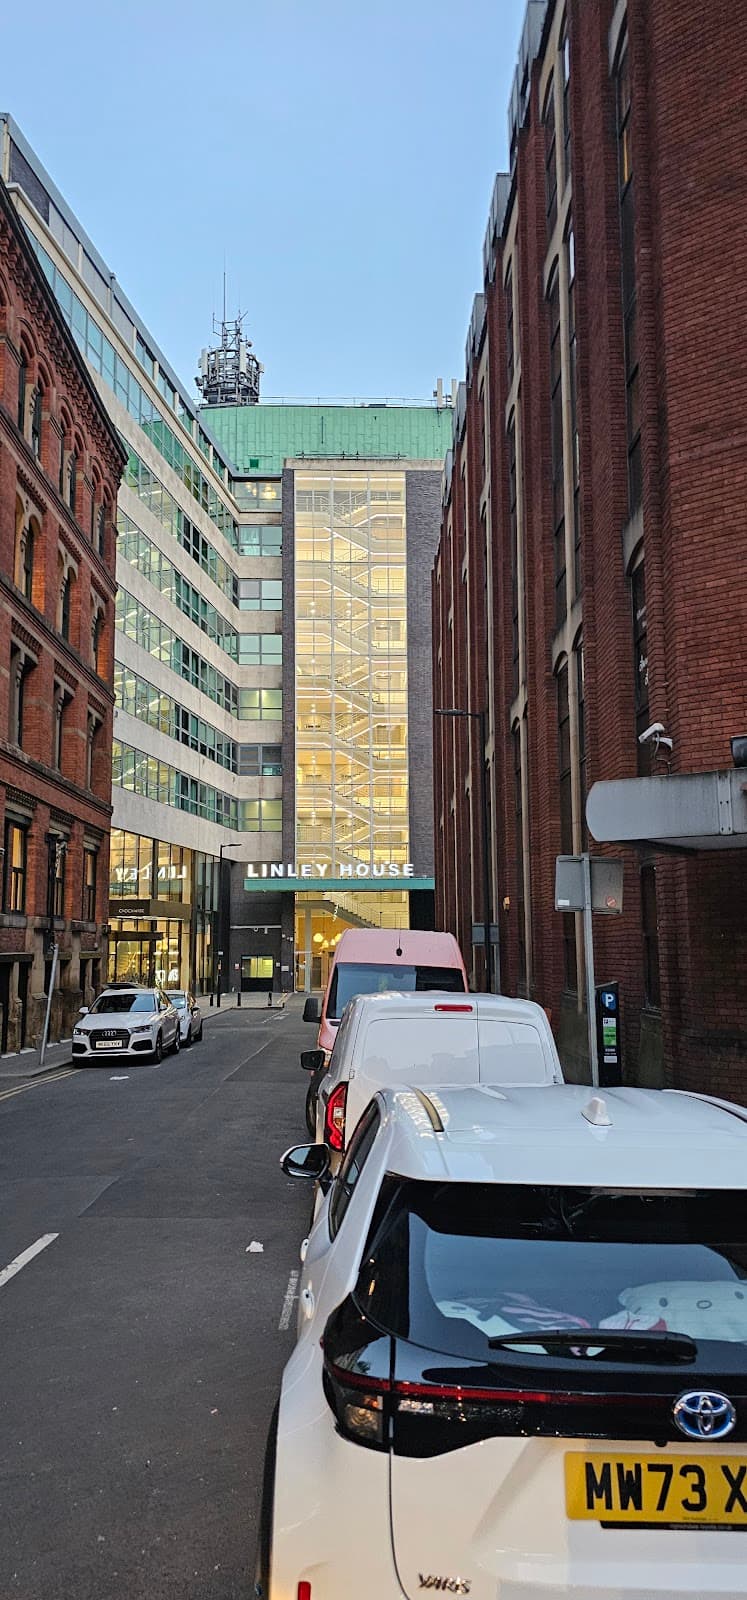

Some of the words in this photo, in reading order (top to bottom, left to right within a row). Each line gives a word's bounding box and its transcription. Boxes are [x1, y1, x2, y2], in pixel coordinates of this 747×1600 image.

[247, 863, 328, 878] LINLEY
[339, 863, 415, 877] HOUSE
[605, 993, 614, 1008] P
[584, 1462, 707, 1512] MW73
[418, 1573, 472, 1594] YARIS
